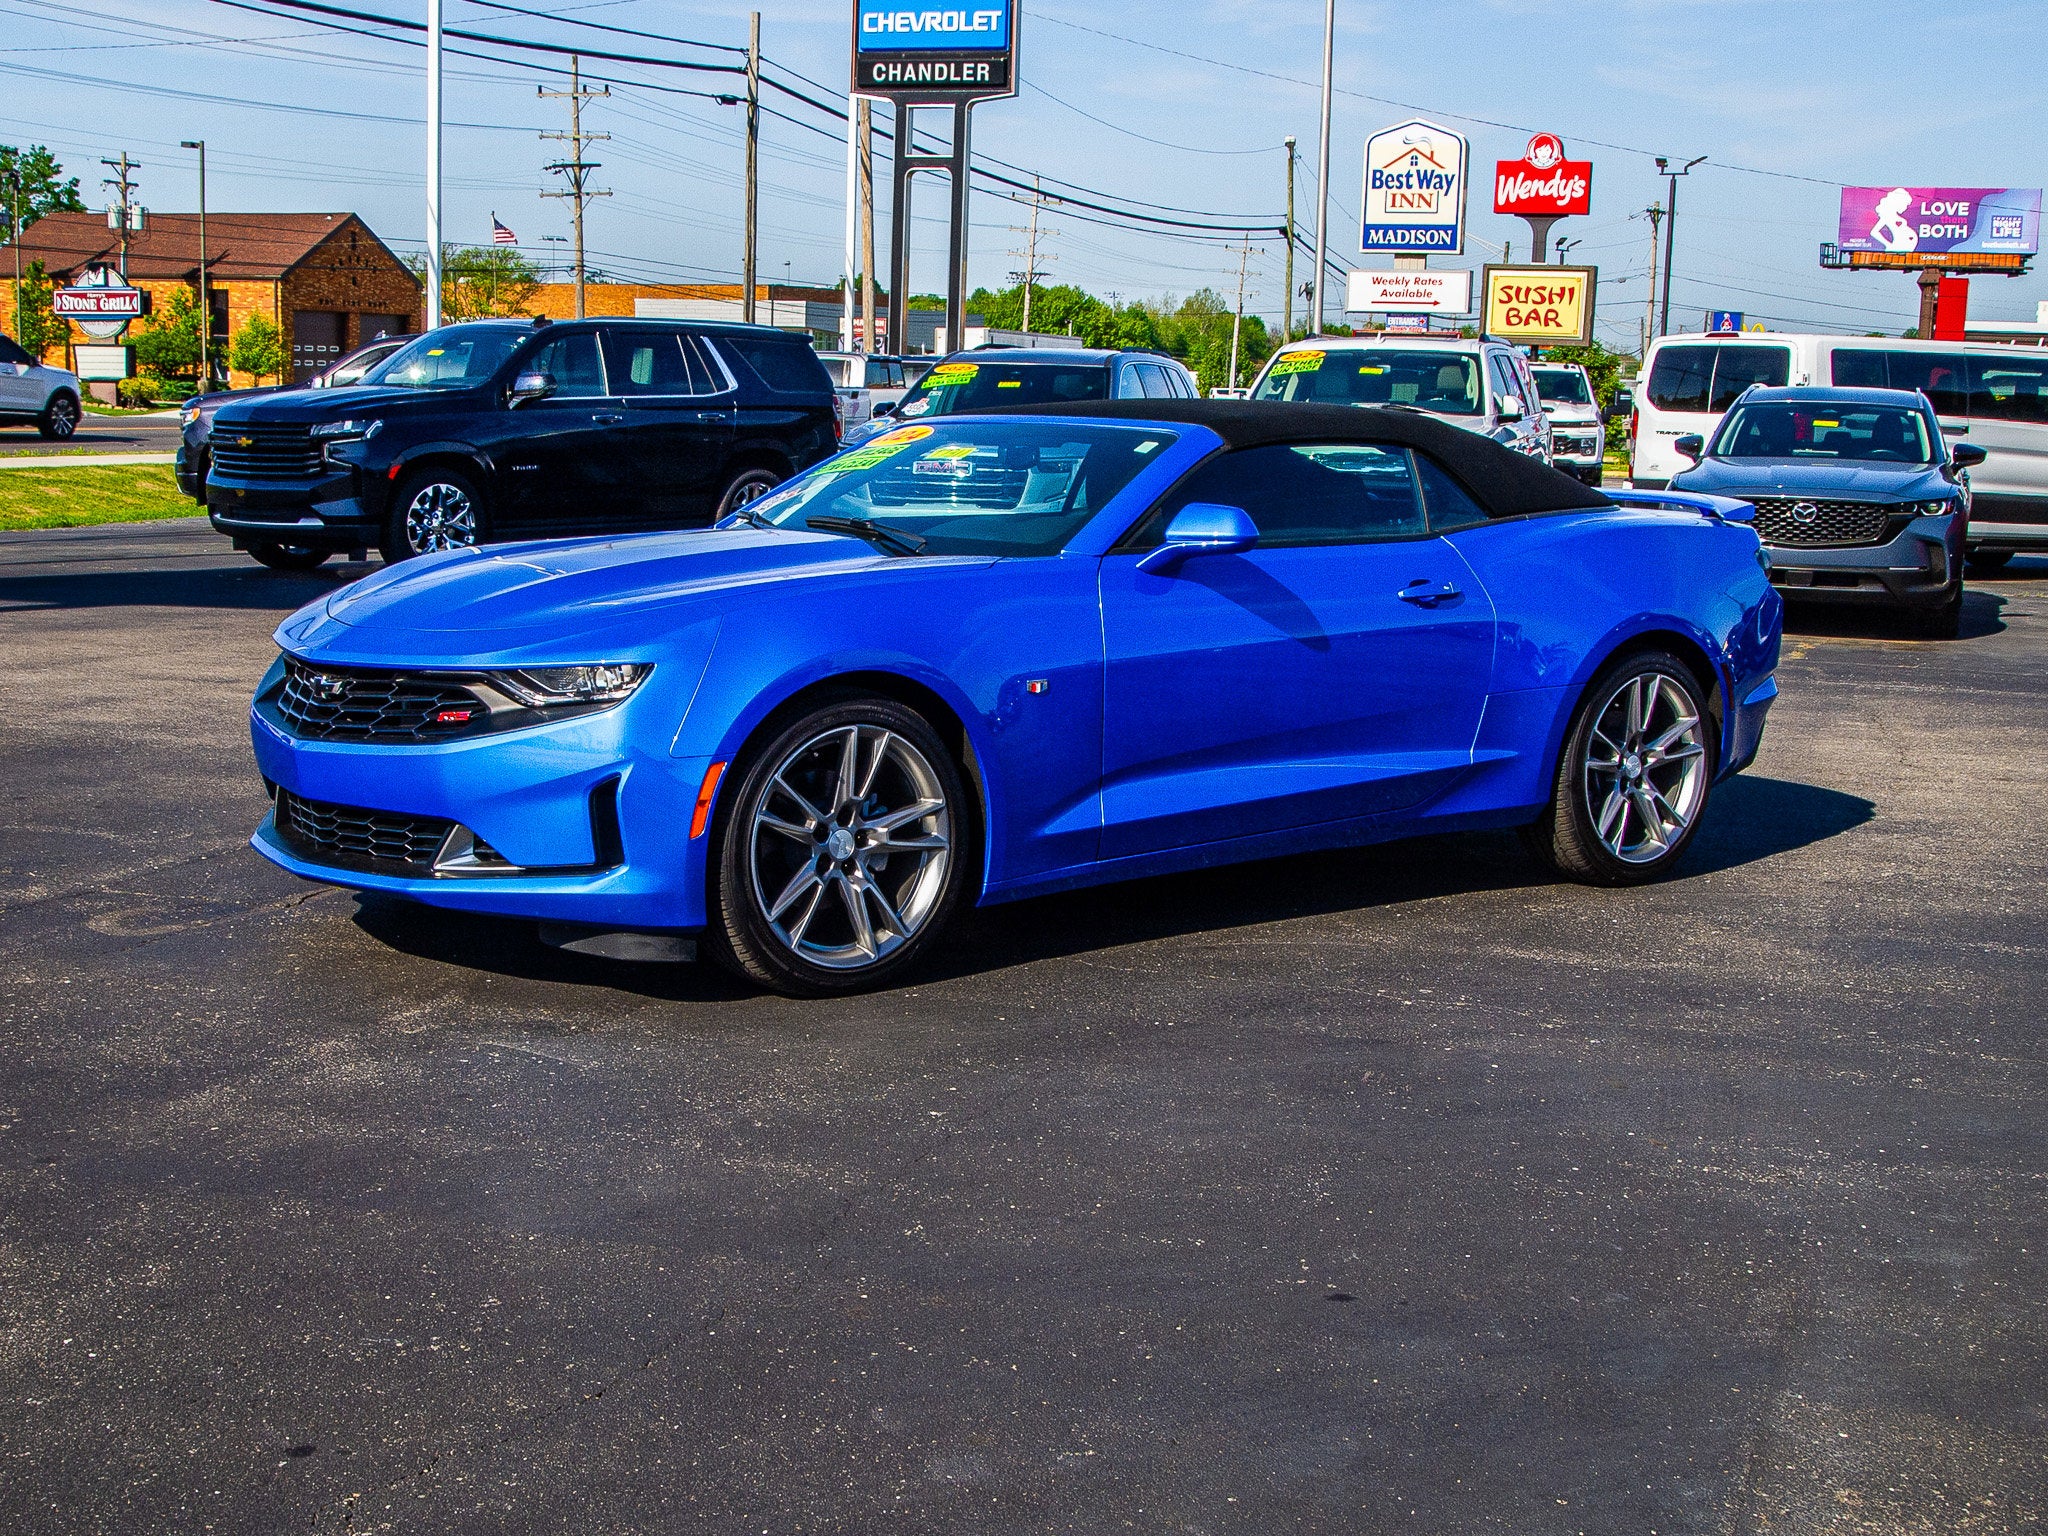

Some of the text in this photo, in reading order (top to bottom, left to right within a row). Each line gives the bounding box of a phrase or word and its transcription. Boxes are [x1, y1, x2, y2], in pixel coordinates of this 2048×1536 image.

[863, 10, 1002, 33] CHEVROLET
[872, 62, 990, 82] CHANDLER
[1371, 169, 1456, 197] Best Way
[1497, 168, 1587, 207] Wendy's
[1390, 193, 1434, 208] INN
[1920, 201, 1970, 216] LOVE
[1940, 215, 1968, 224] them
[1367, 229, 1453, 245] MADISON
[1918, 223, 1968, 239] BOTH
[1992, 227, 2021, 238] LIFE
[1372, 276, 1443, 287] Weekly Rates
[1380, 289, 1433, 298] Available
[1498, 284, 1575, 306] SUSHI
[61, 294, 133, 311] STONE GRILL
[1505, 307, 1563, 328] BAR
[1285, 351, 1321, 360] 2024
[1273, 359, 1321, 370] LEATHER
[916, 461, 969, 475] GMC
